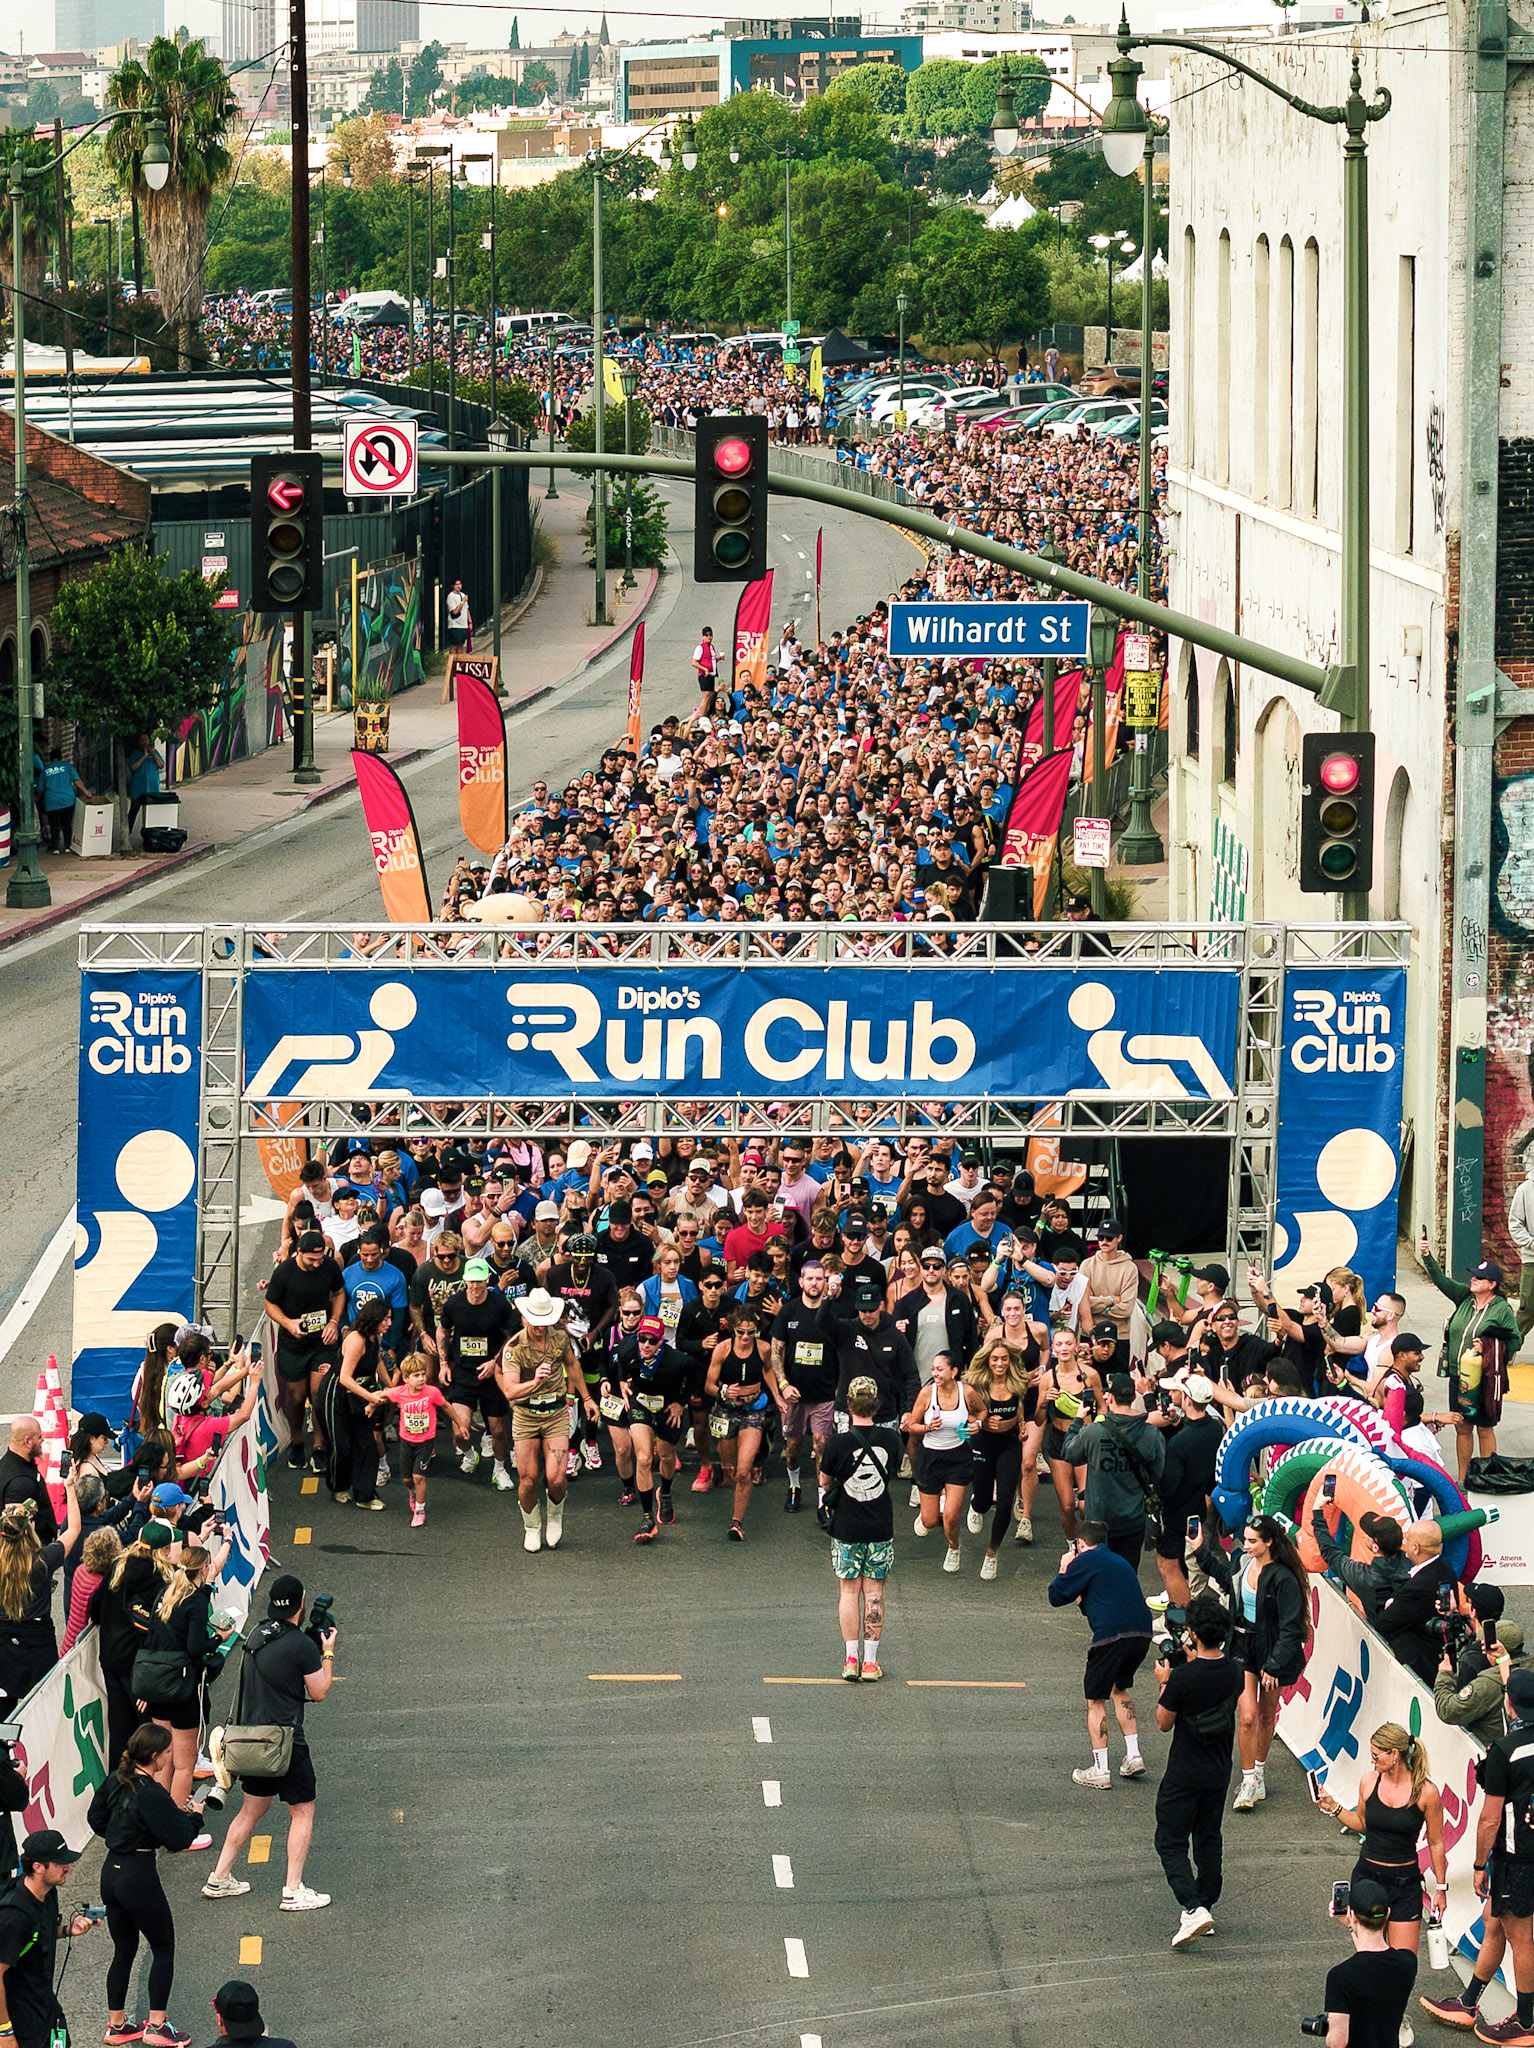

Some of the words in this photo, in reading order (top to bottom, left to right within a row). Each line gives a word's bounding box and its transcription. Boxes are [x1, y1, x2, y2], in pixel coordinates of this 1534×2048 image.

[737, 631, 766, 649] Run
[907, 616, 1027, 643] Wilhardt
[1039, 616, 1072, 643] St
[736, 648, 767, 663] Club
[456, 662, 489, 677] KISSA
[460, 746, 502, 767] Run
[460, 766, 504, 784] Club
[370, 831, 413, 854] Run
[1006, 829, 1052, 856] Run
[1087, 831, 1108, 840] STOPPING
[375, 850, 419, 874] Club
[139, 992, 177, 1006] Diplo's
[618, 986, 701, 1014] Diplo's
[1343, 991, 1381, 1005] Diplo's
[90, 991, 187, 1036] Run
[1293, 990, 1391, 1036] Run
[506, 982, 722, 1082] Run
[743, 998, 976, 1081] Club
[88, 1036, 192, 1075] Club
[1291, 1035, 1396, 1073] Club
[269, 1151, 302, 1175] Club
[306, 1317, 321, 1327] 502
[663, 1310, 679, 1320] 229
[604, 1401, 618, 1411] 627
